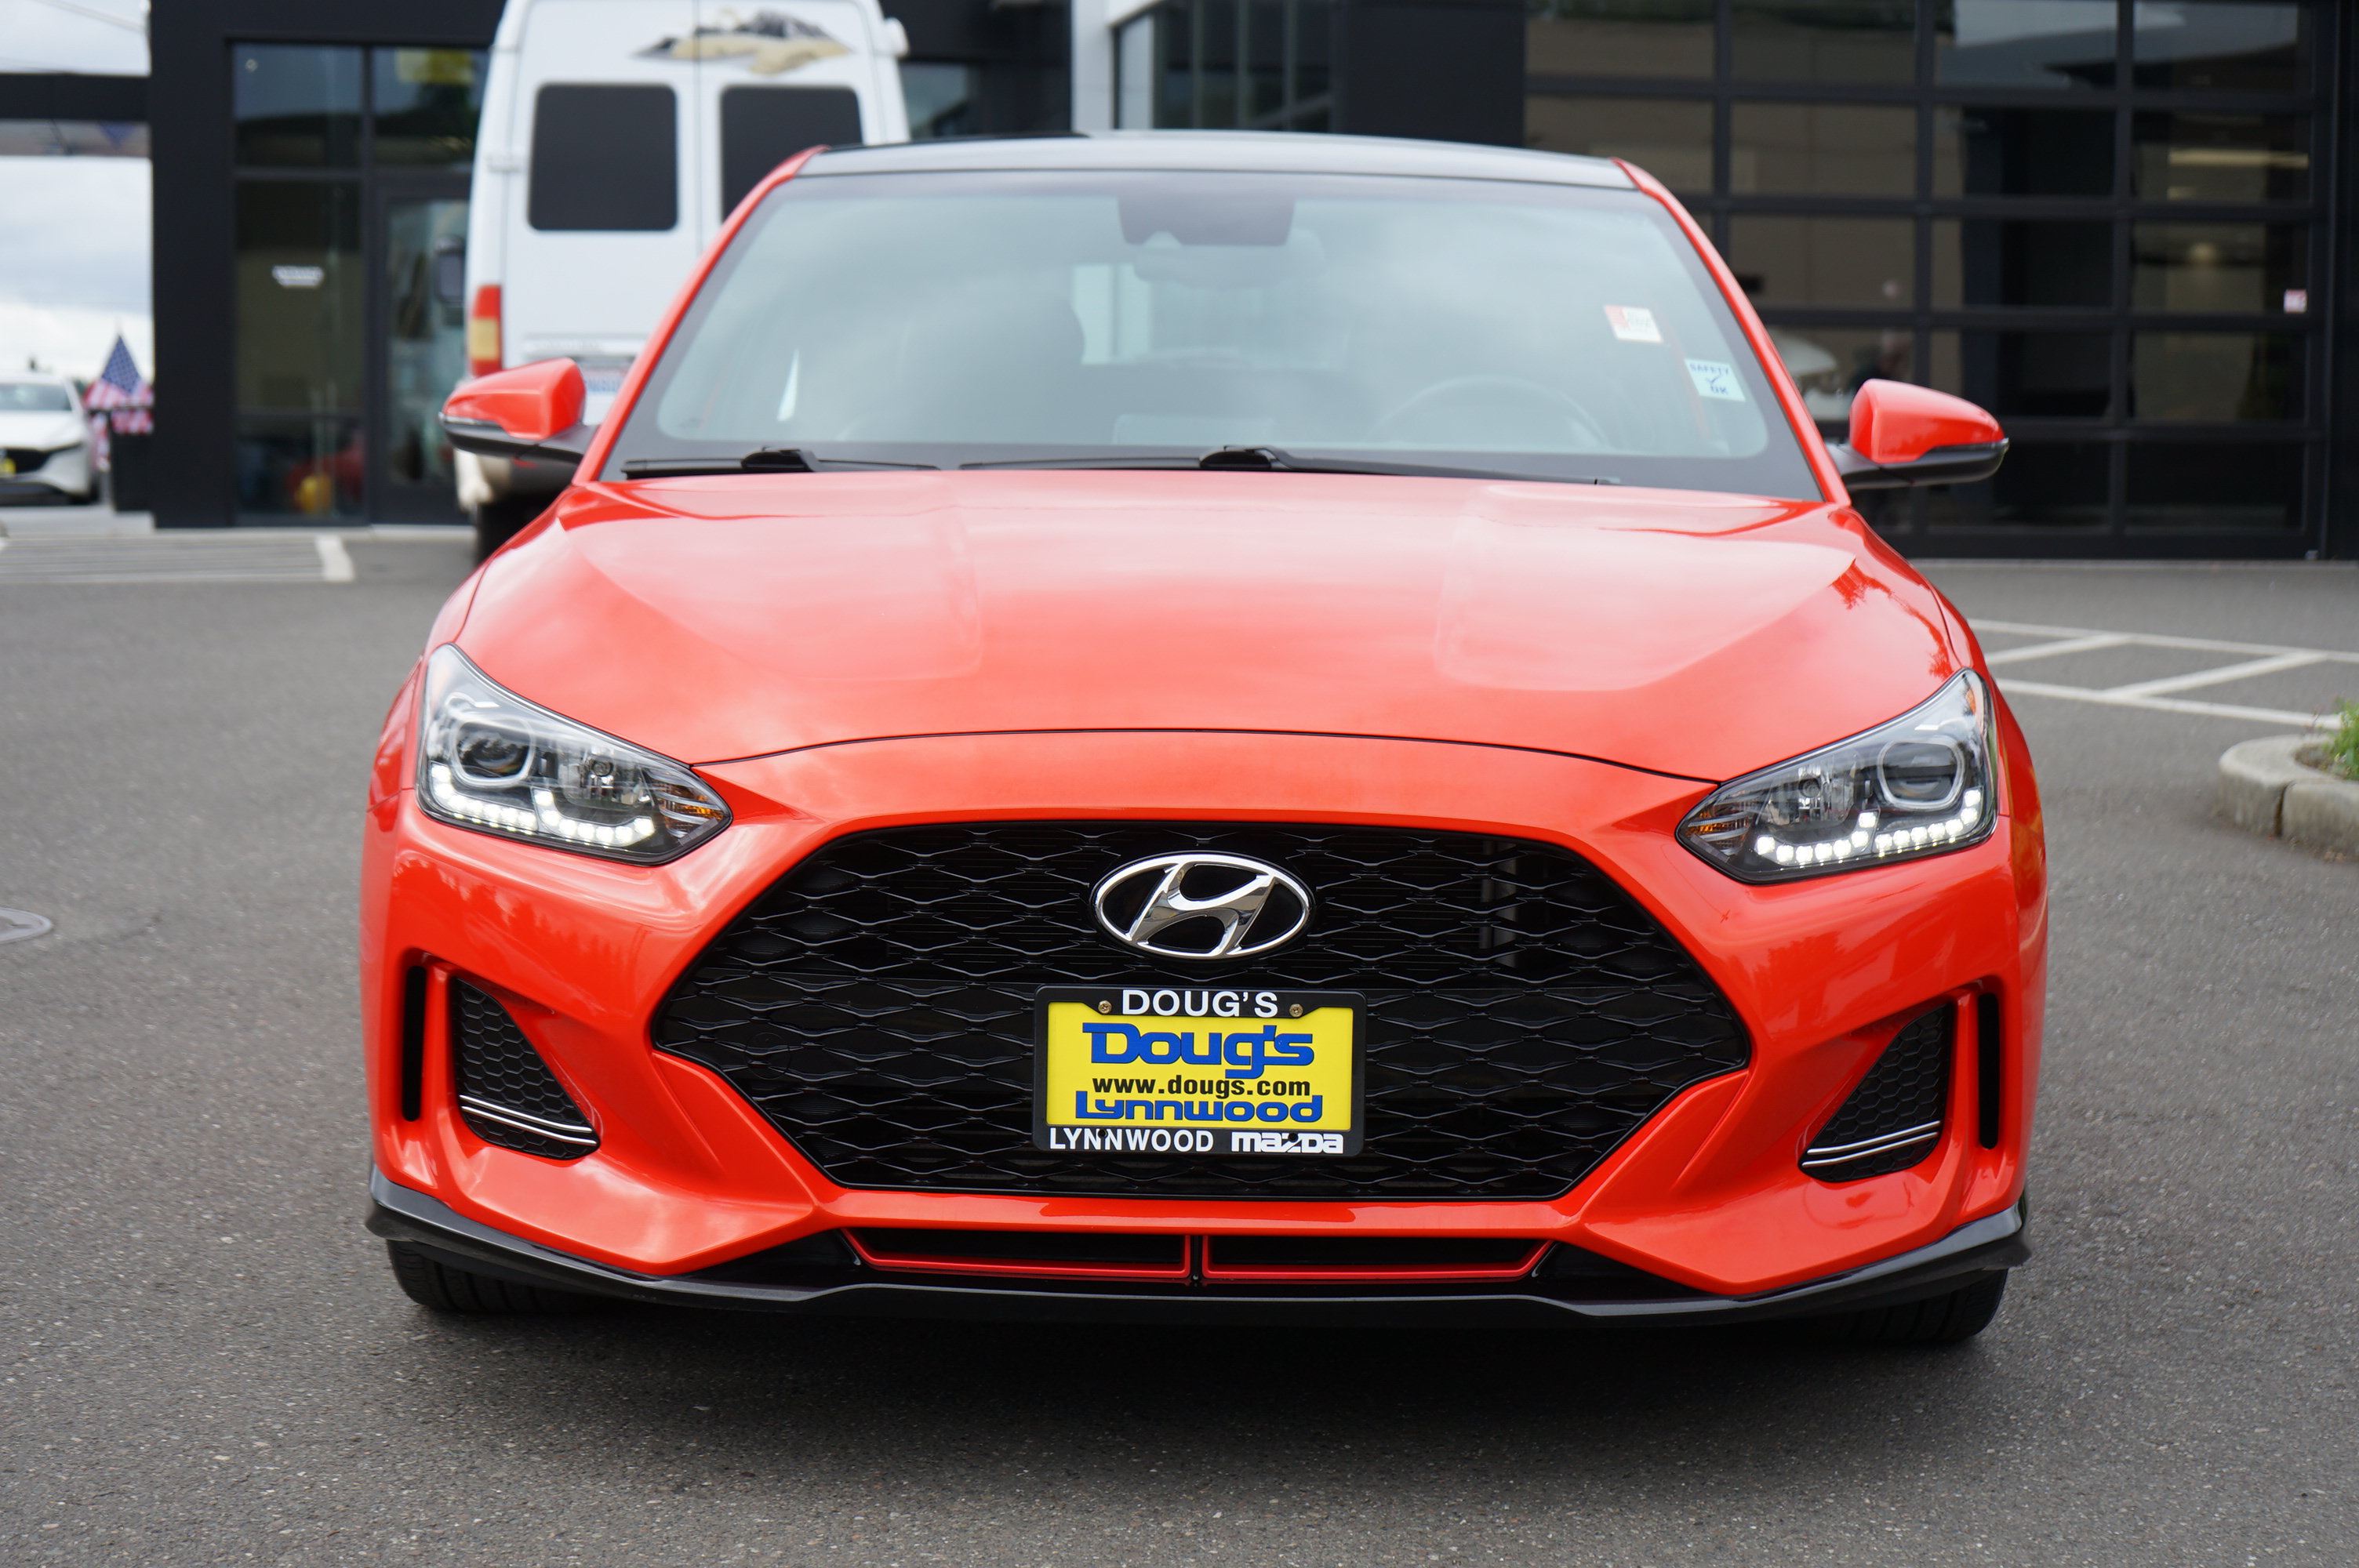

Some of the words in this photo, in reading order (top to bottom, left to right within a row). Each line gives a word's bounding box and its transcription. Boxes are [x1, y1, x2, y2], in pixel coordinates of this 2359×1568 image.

[1122, 989, 1278, 1018] DOUG'S
[1082, 1022, 1315, 1080] Doug's
[1092, 1075, 1310, 1099] www.dougs.com
[1075, 1091, 1323, 1122] Lynnwood
[1049, 1127, 1214, 1152] LYNNWOOD
